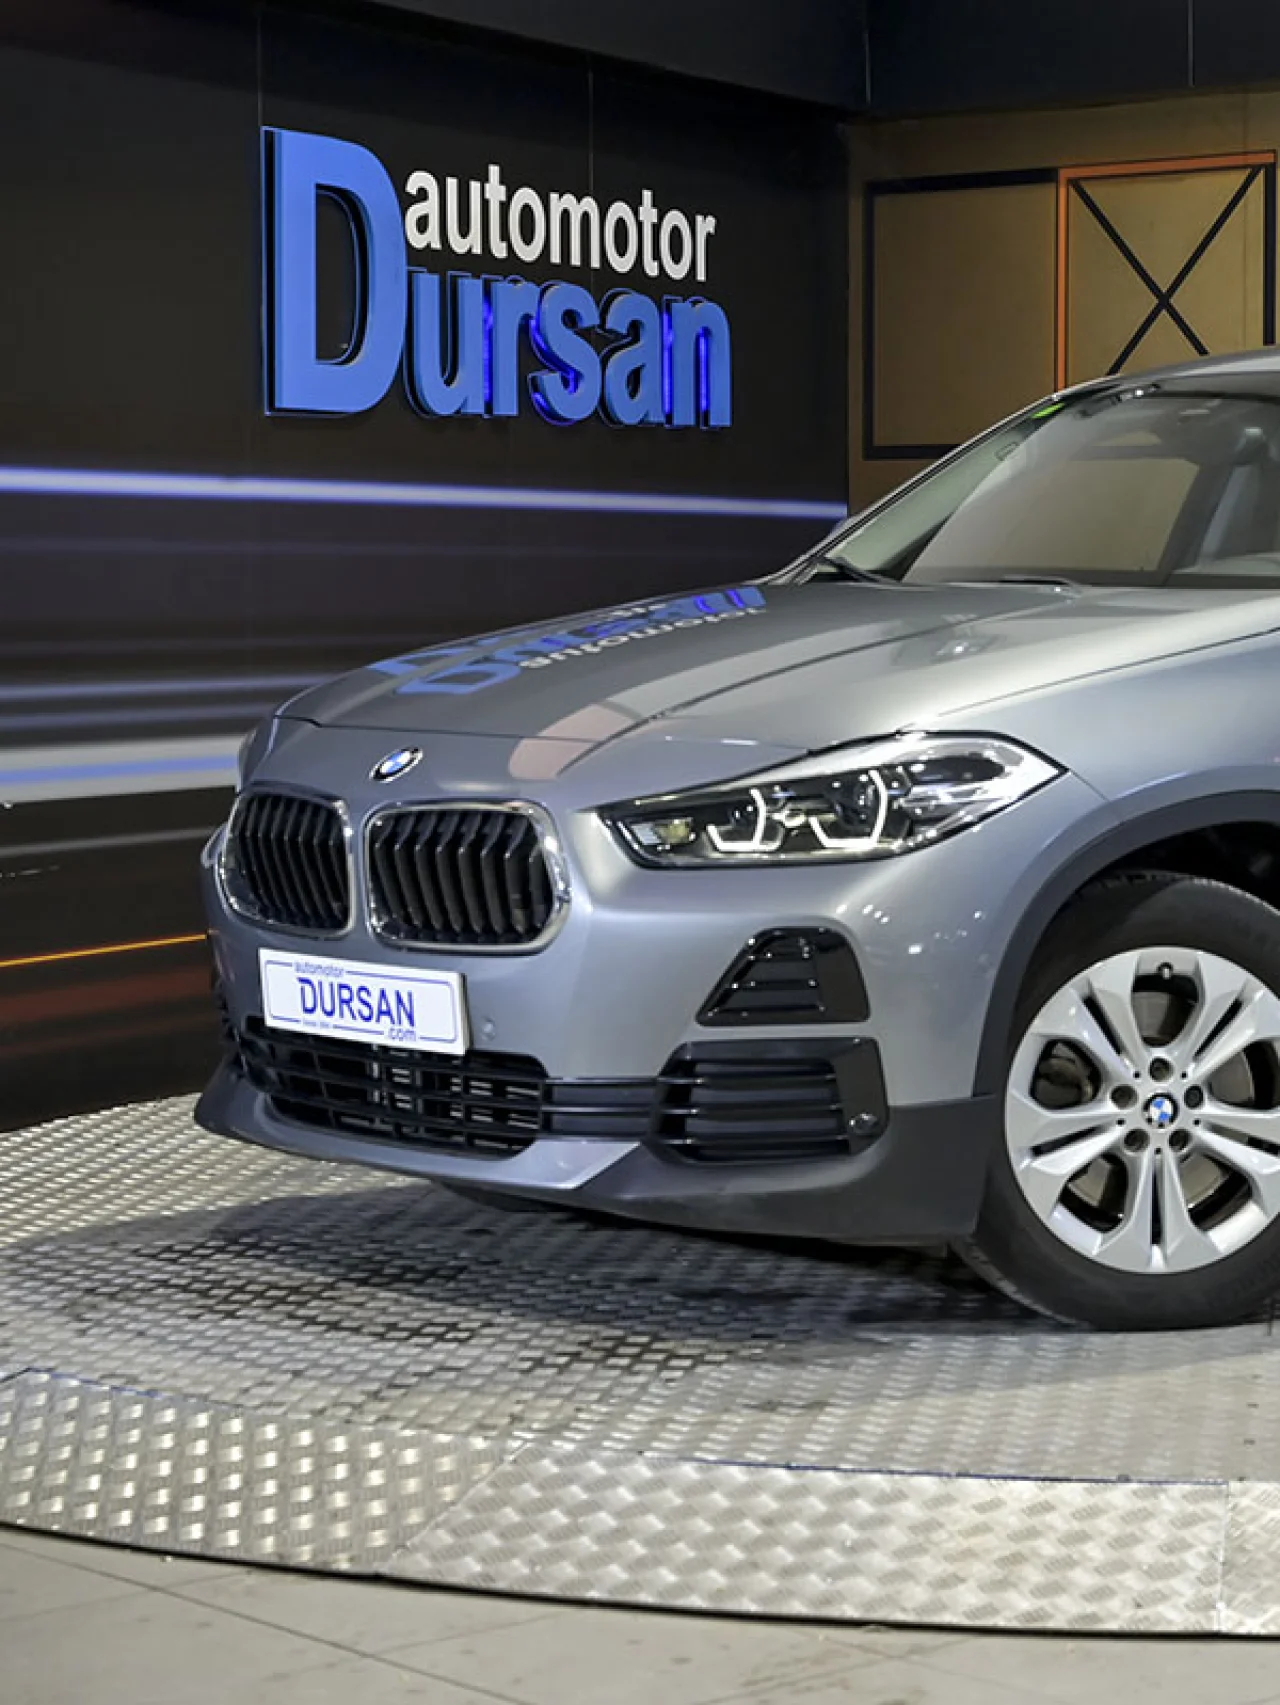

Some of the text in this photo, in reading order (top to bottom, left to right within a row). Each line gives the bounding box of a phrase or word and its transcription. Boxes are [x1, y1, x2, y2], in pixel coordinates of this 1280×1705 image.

[261, 126, 733, 430] Dursan
[404, 164, 716, 281] automotor
[297, 976, 415, 1026] DURSAN
